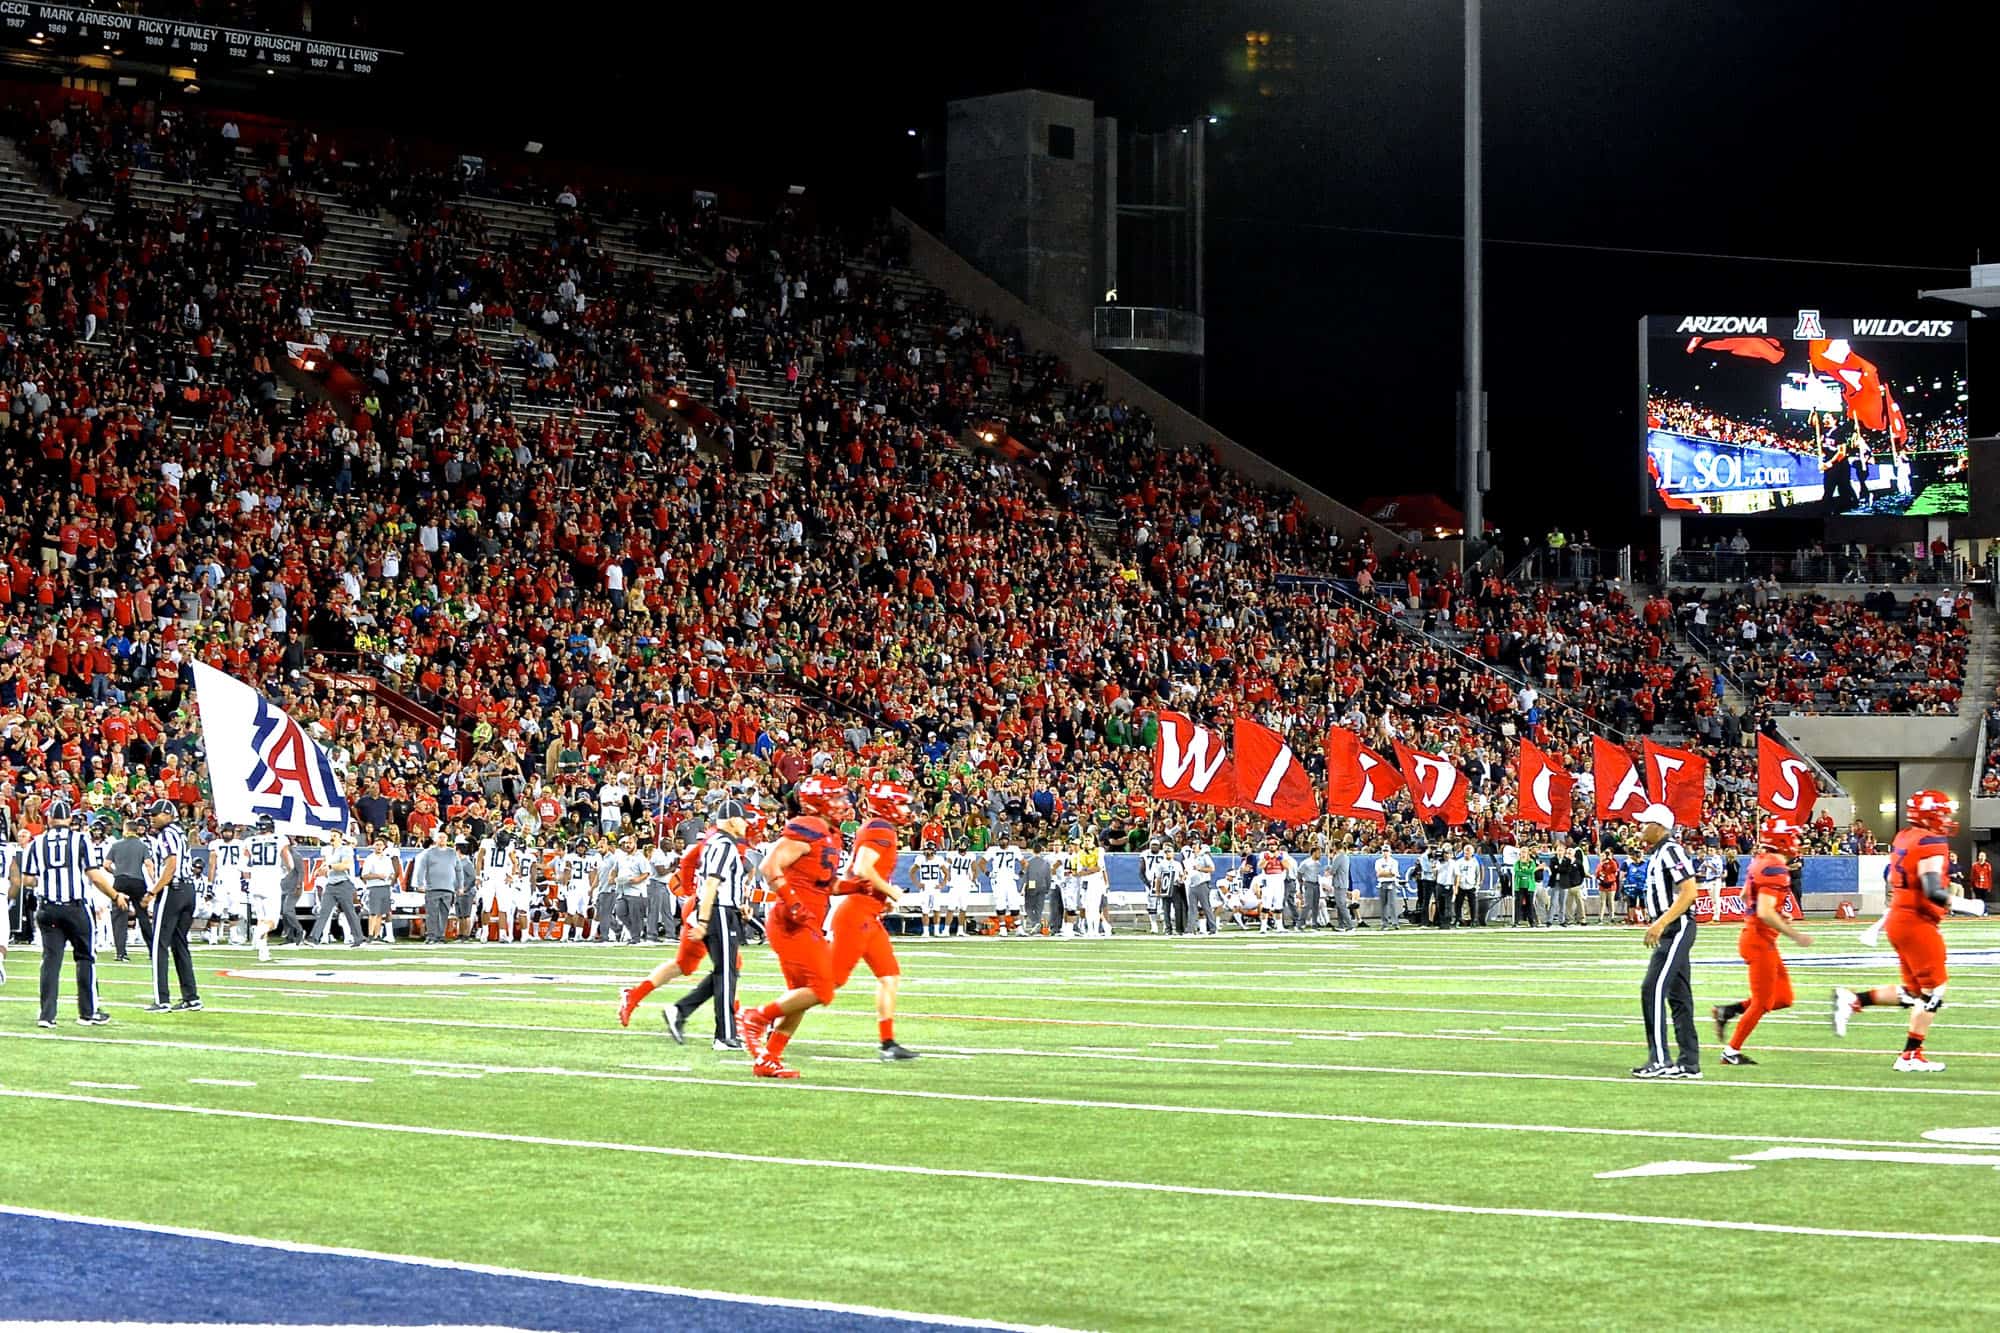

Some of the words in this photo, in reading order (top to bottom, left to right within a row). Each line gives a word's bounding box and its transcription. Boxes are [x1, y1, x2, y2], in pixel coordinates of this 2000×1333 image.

[0, 2, 31, 16] CECIL
[40, 6, 74, 21] MARK
[76, 12, 132, 30] ARNESON
[138, 19, 172, 35] RICKY
[174, 25, 218, 41] HUNLEY
[224, 31, 252, 45] TEDY
[254, 35, 302, 52] BRUSCHI
[306, 42, 347, 59] DARRYLL
[348, 48, 379, 62] LEWIS
[103, 30, 120, 40] 1971
[1676, 316, 1767, 334] ARIZONA
[1853, 319, 1953, 337] WILDCATS
[251, 841, 278, 866] 90
[490, 847, 506, 868] 10
[995, 851, 1014, 869] 72
[921, 864, 940, 880] 26
[952, 857, 972, 875] 44
